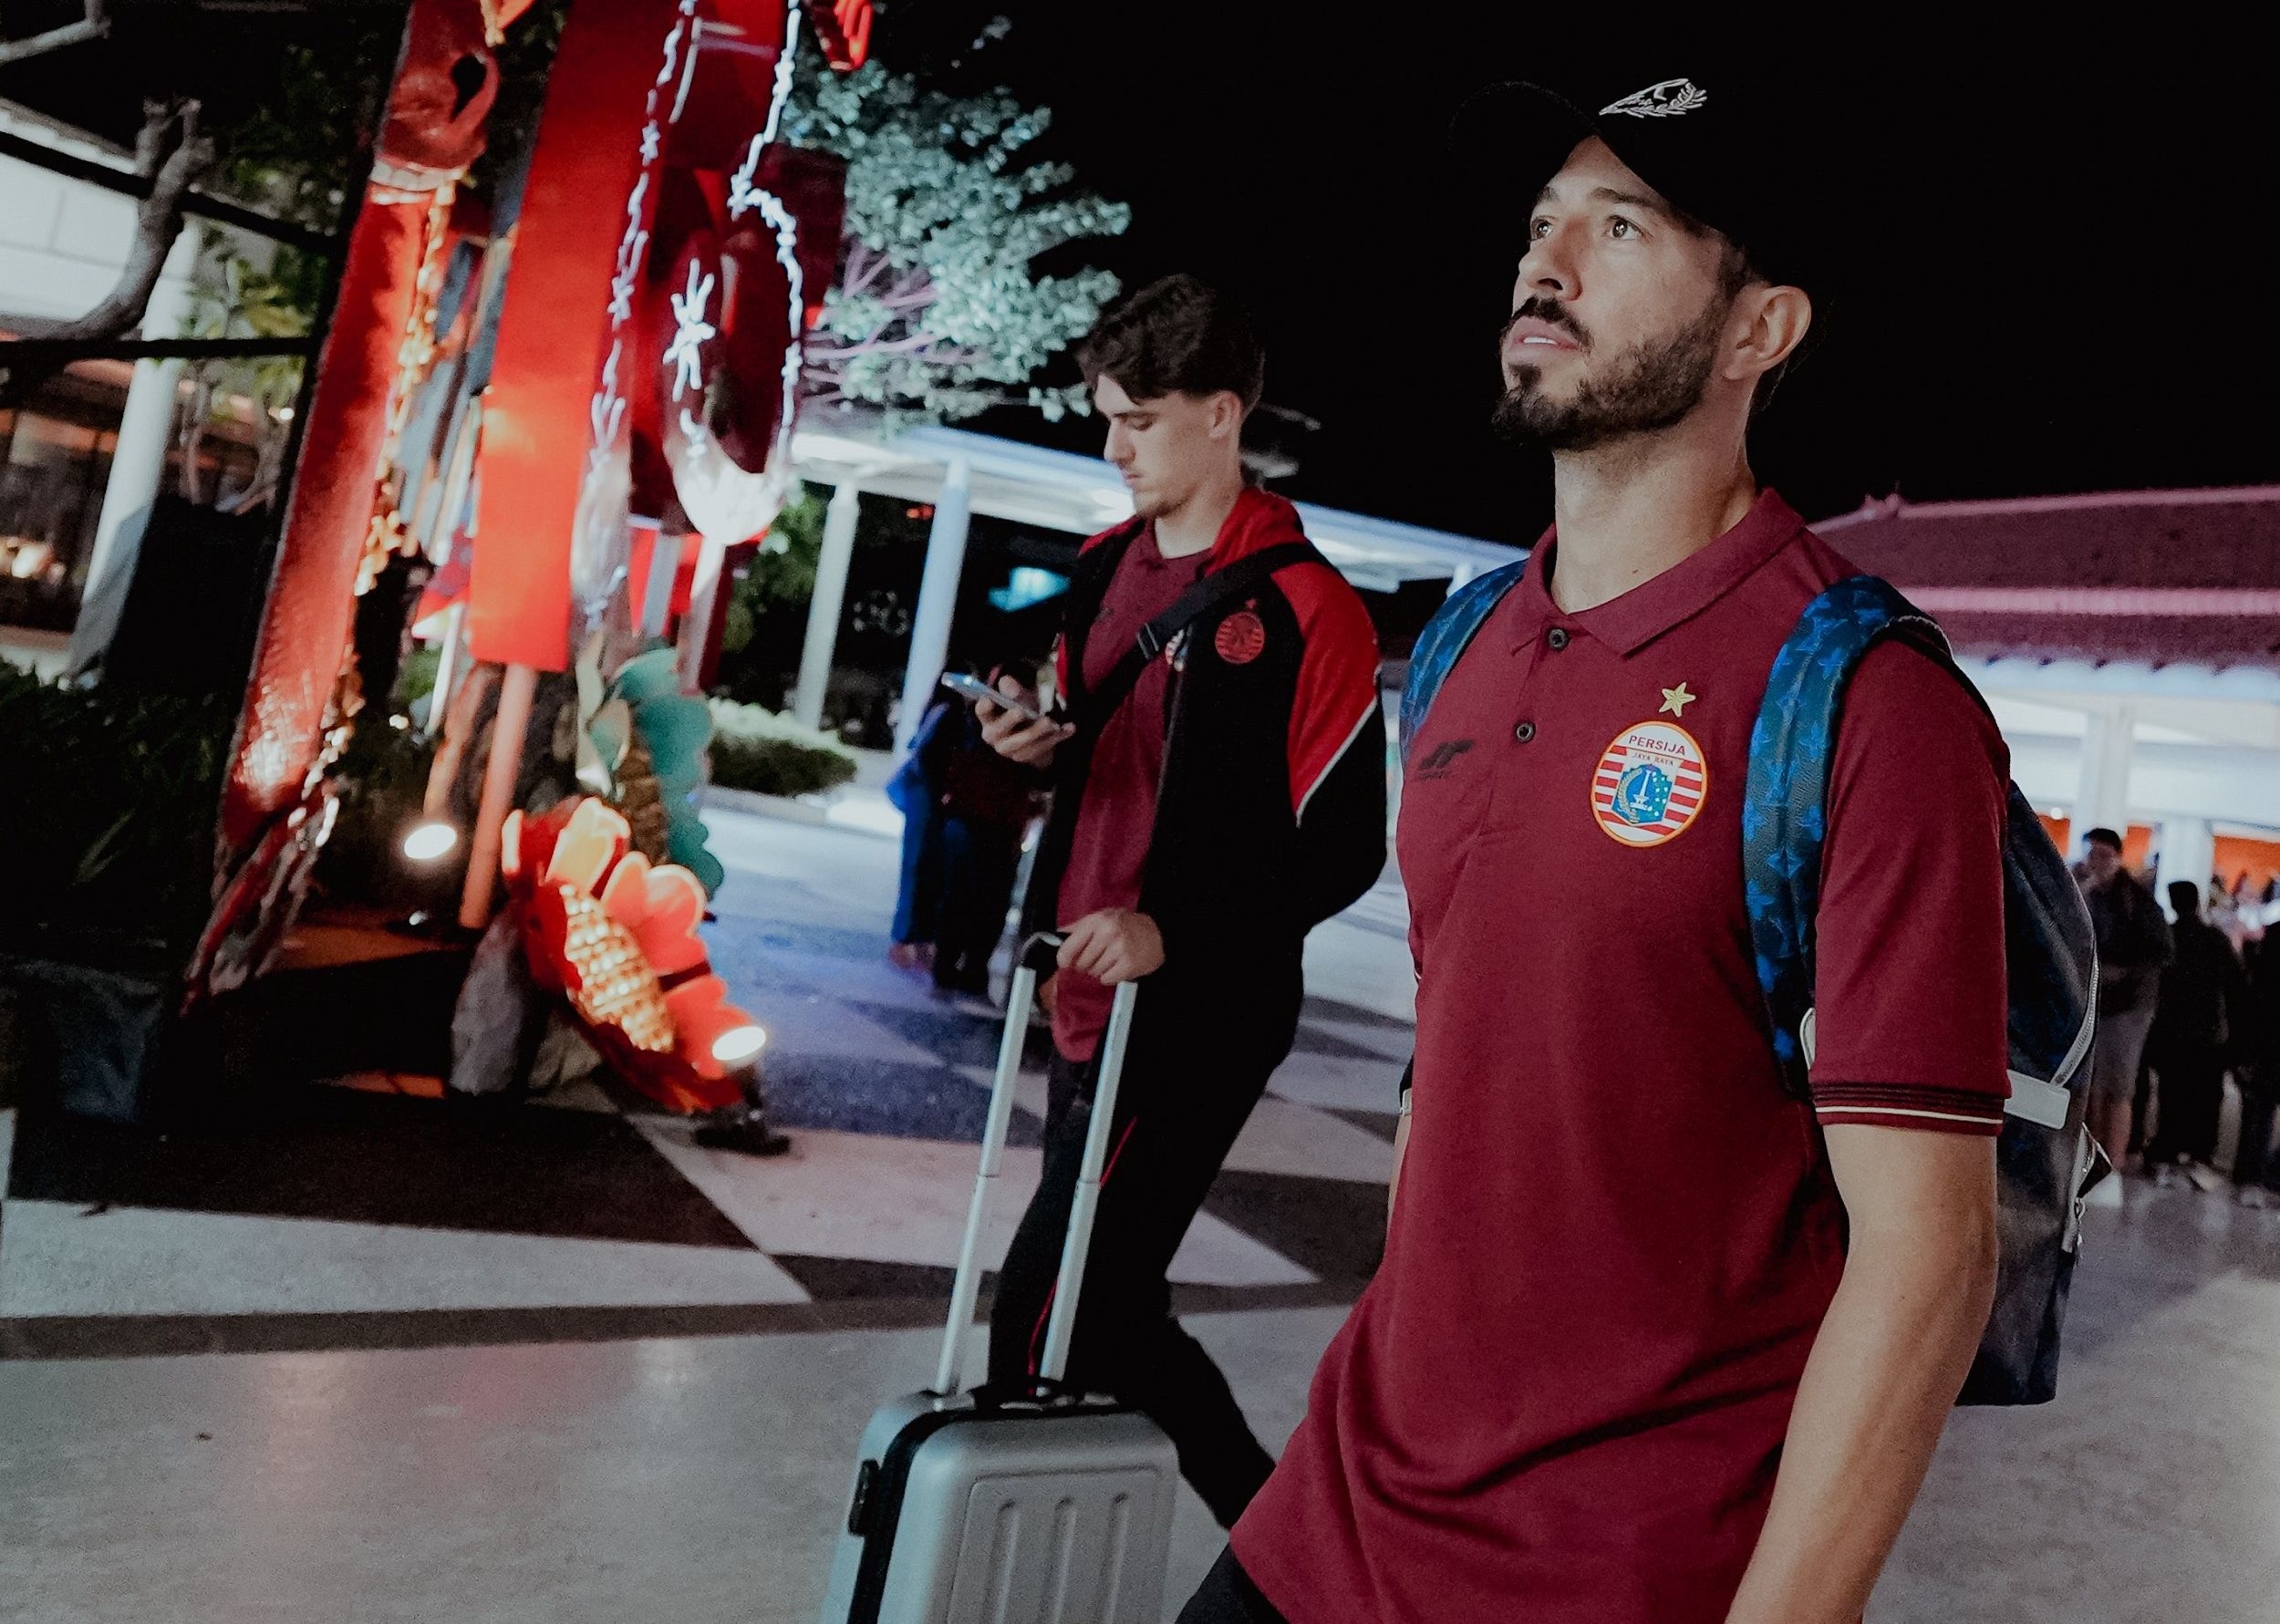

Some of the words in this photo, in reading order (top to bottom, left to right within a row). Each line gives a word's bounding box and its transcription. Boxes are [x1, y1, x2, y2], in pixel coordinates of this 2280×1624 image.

[1629, 735, 1685, 756] PERSIJA
[1632, 752, 1651, 761] JAYA
[1654, 757, 1674, 766] RAYA
